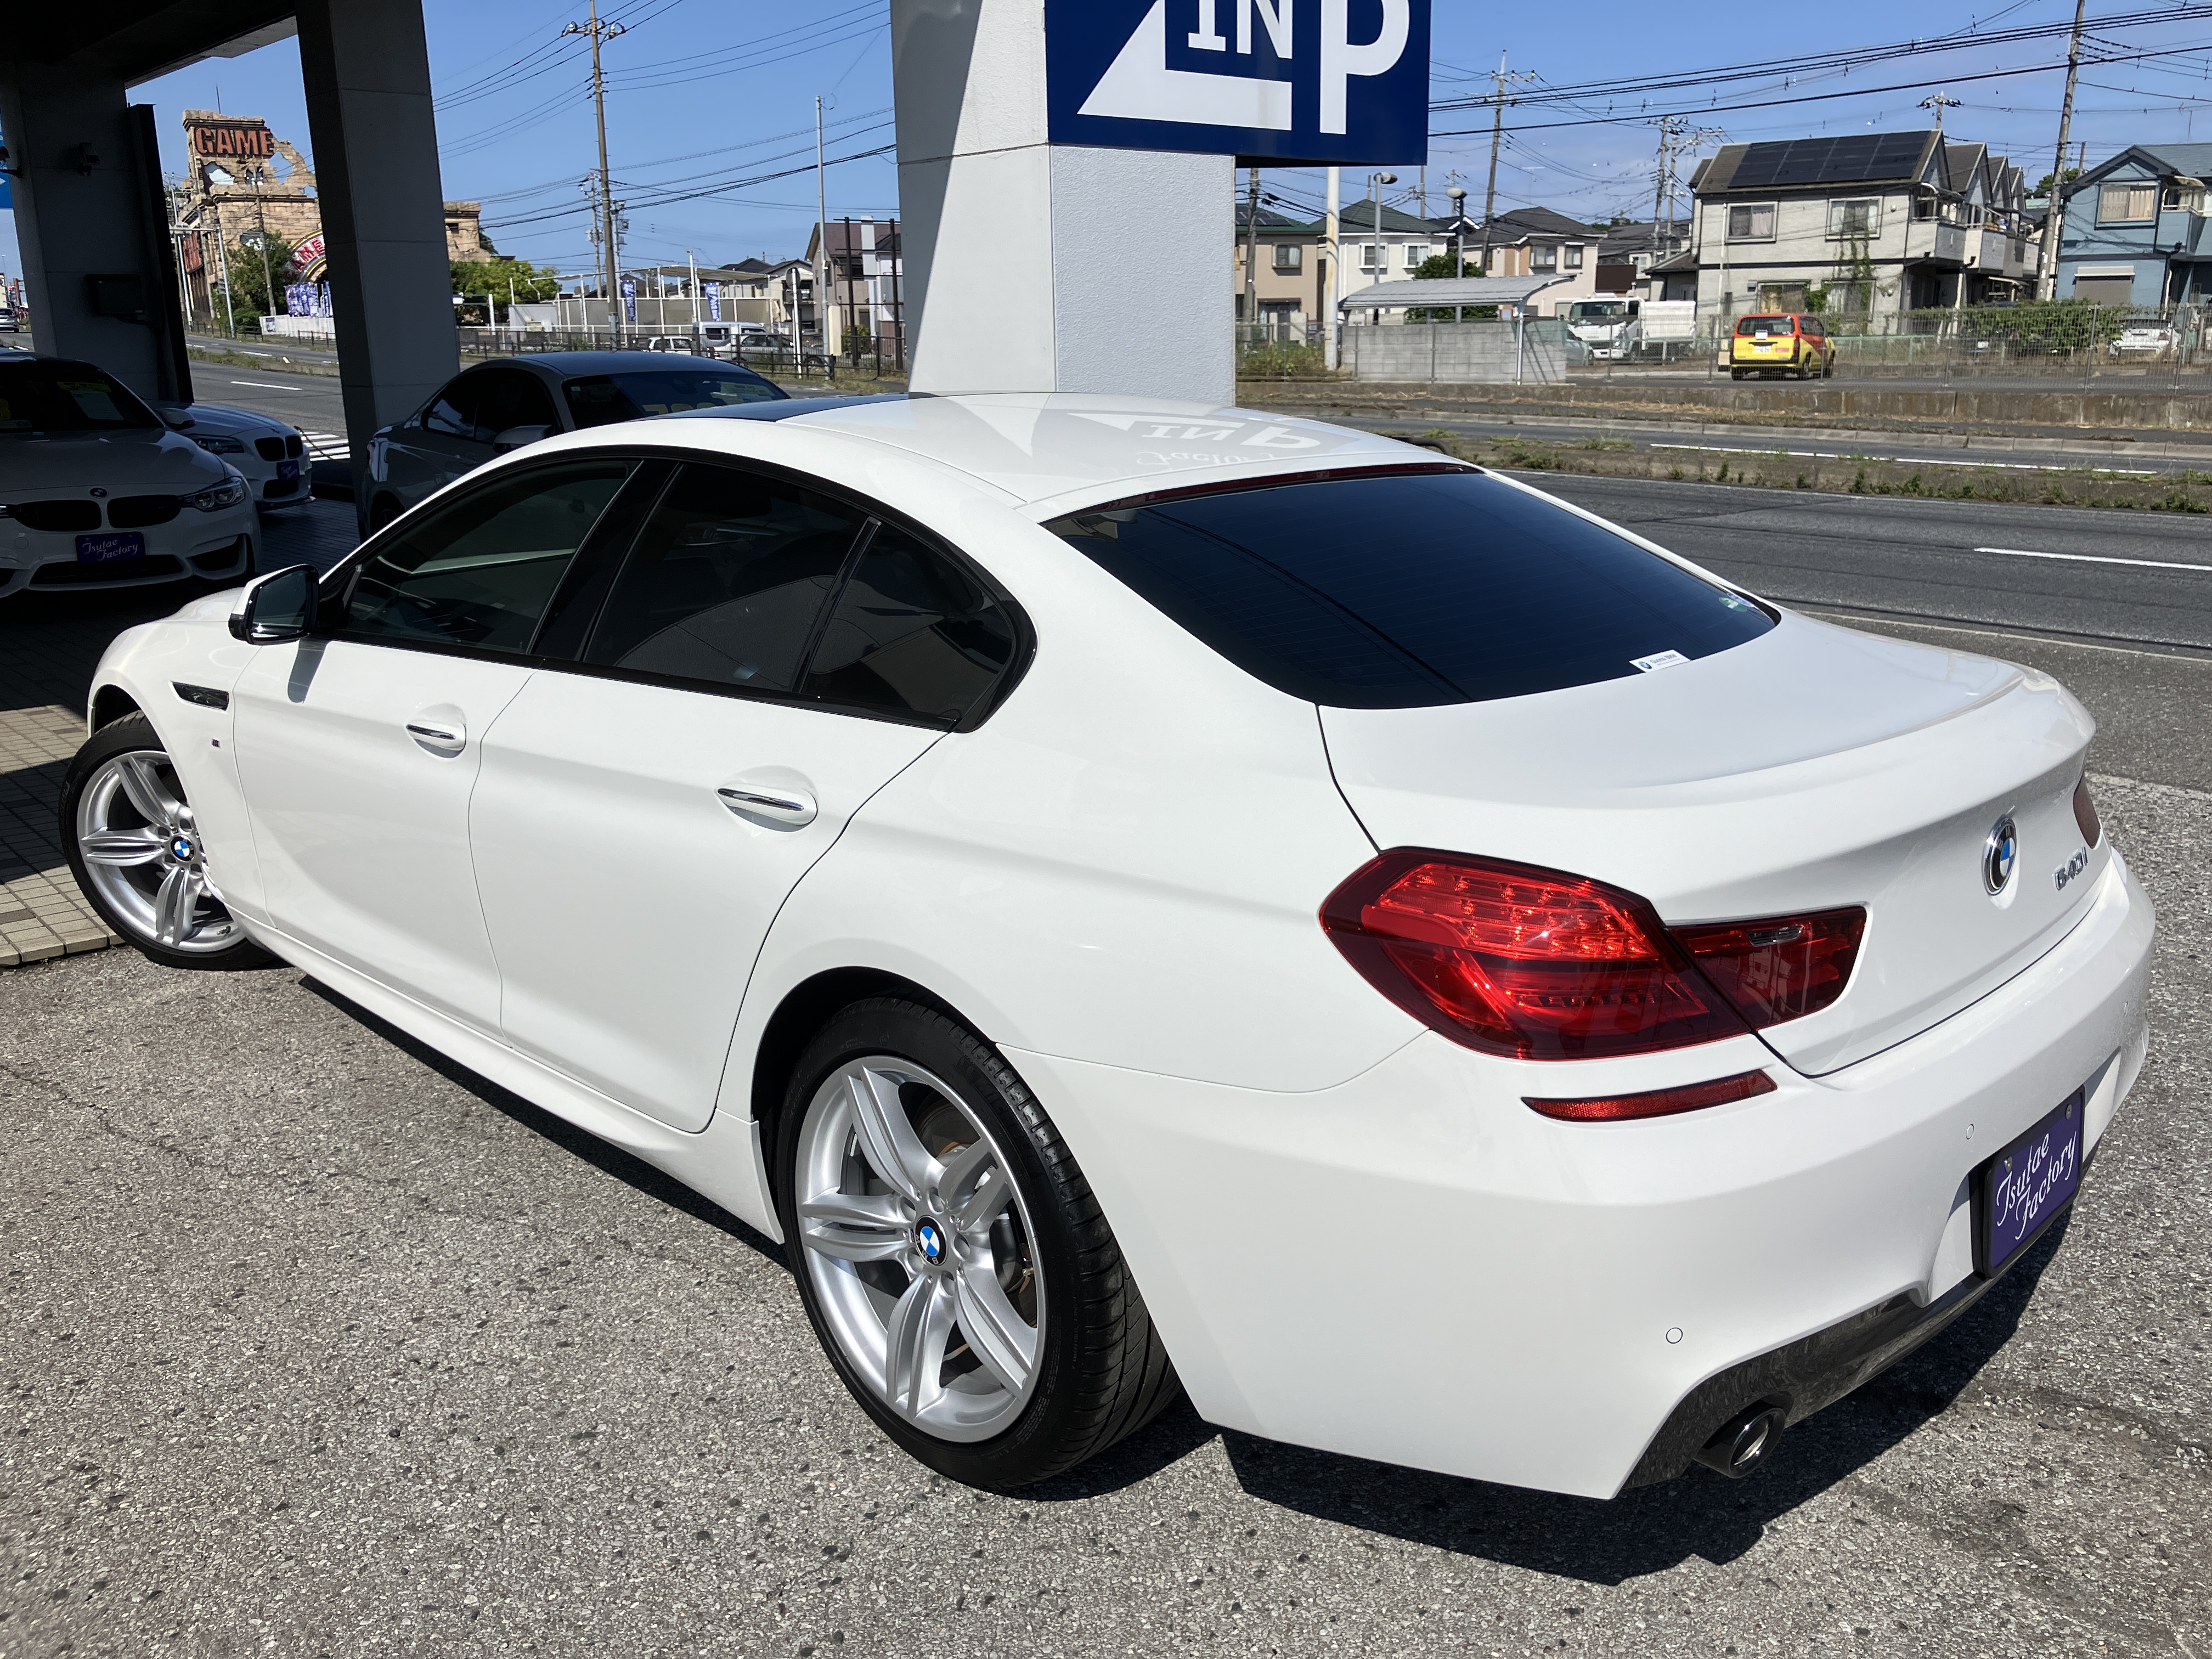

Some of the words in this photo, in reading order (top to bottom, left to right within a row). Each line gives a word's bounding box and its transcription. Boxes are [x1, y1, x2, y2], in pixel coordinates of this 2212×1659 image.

[1319, 0, 1410, 134] P
[195, 127, 274, 156] GAME
[97, 544, 138, 561] Factory
[2015, 1130, 2077, 1240] Factory
